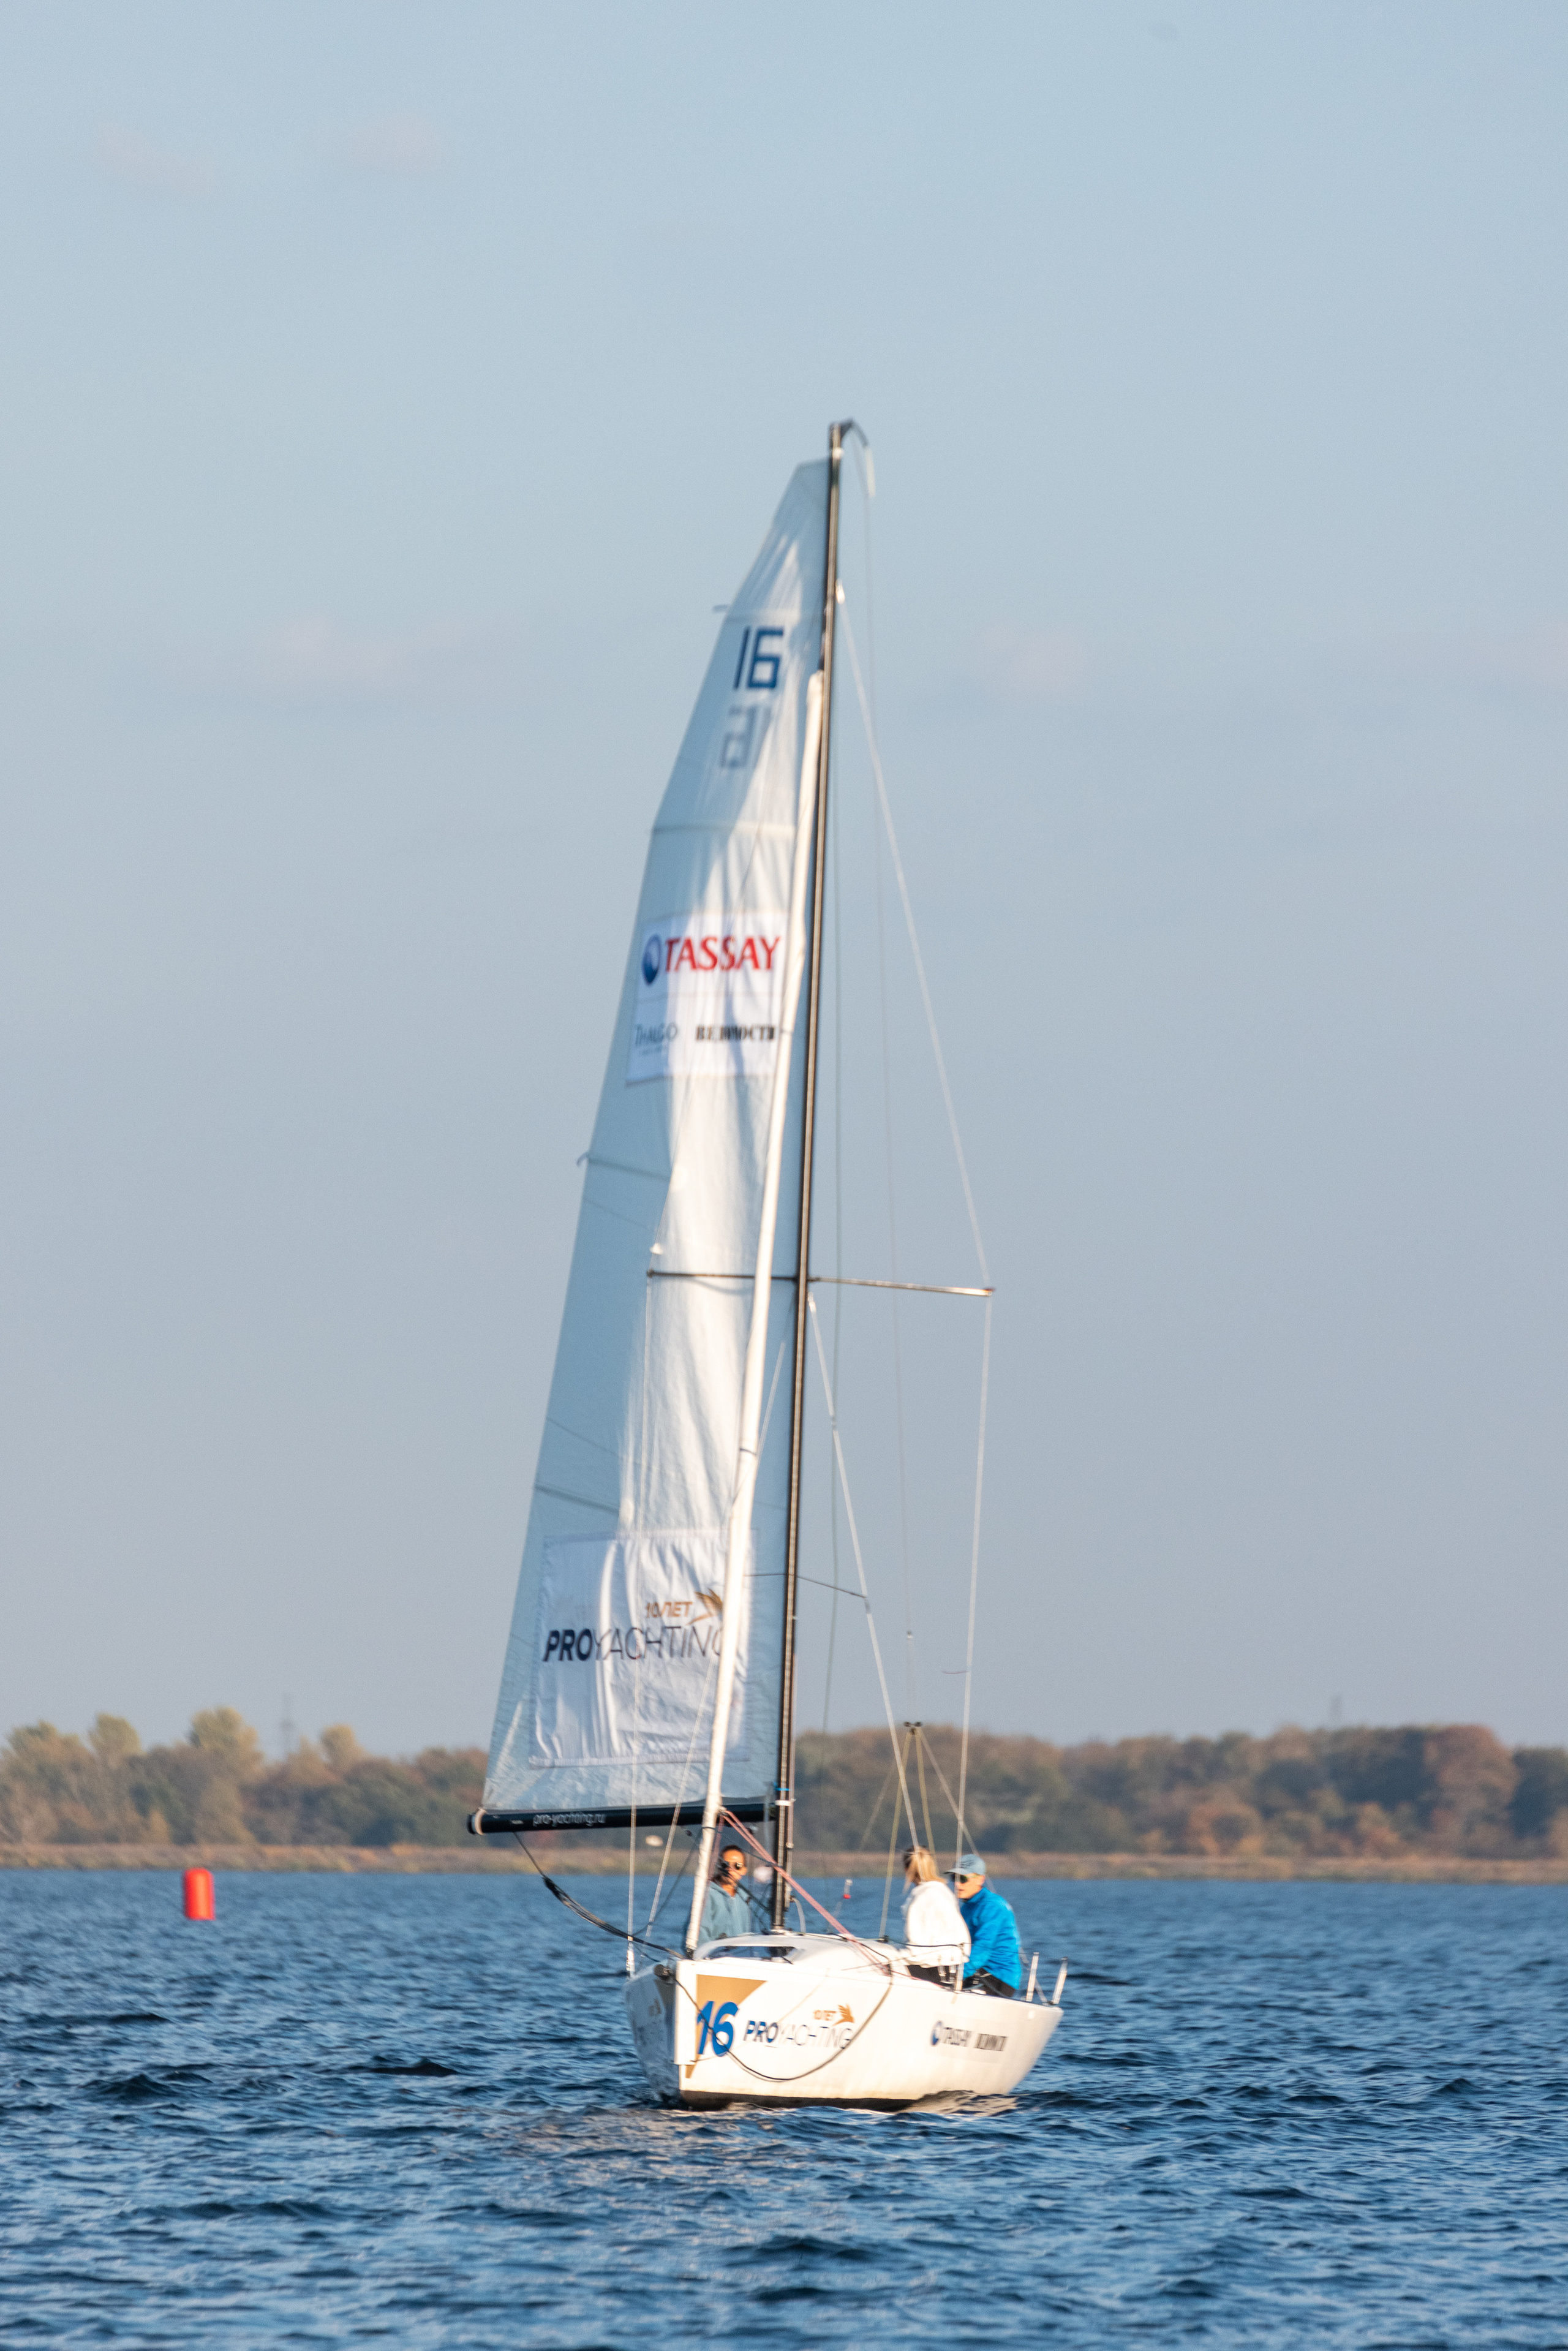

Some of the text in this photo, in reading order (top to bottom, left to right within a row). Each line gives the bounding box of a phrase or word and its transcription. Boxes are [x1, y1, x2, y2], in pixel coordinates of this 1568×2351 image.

[734, 626, 783, 689] 16
[665, 935, 781, 972] TASSAY
[696, 2000, 739, 2057] 16
